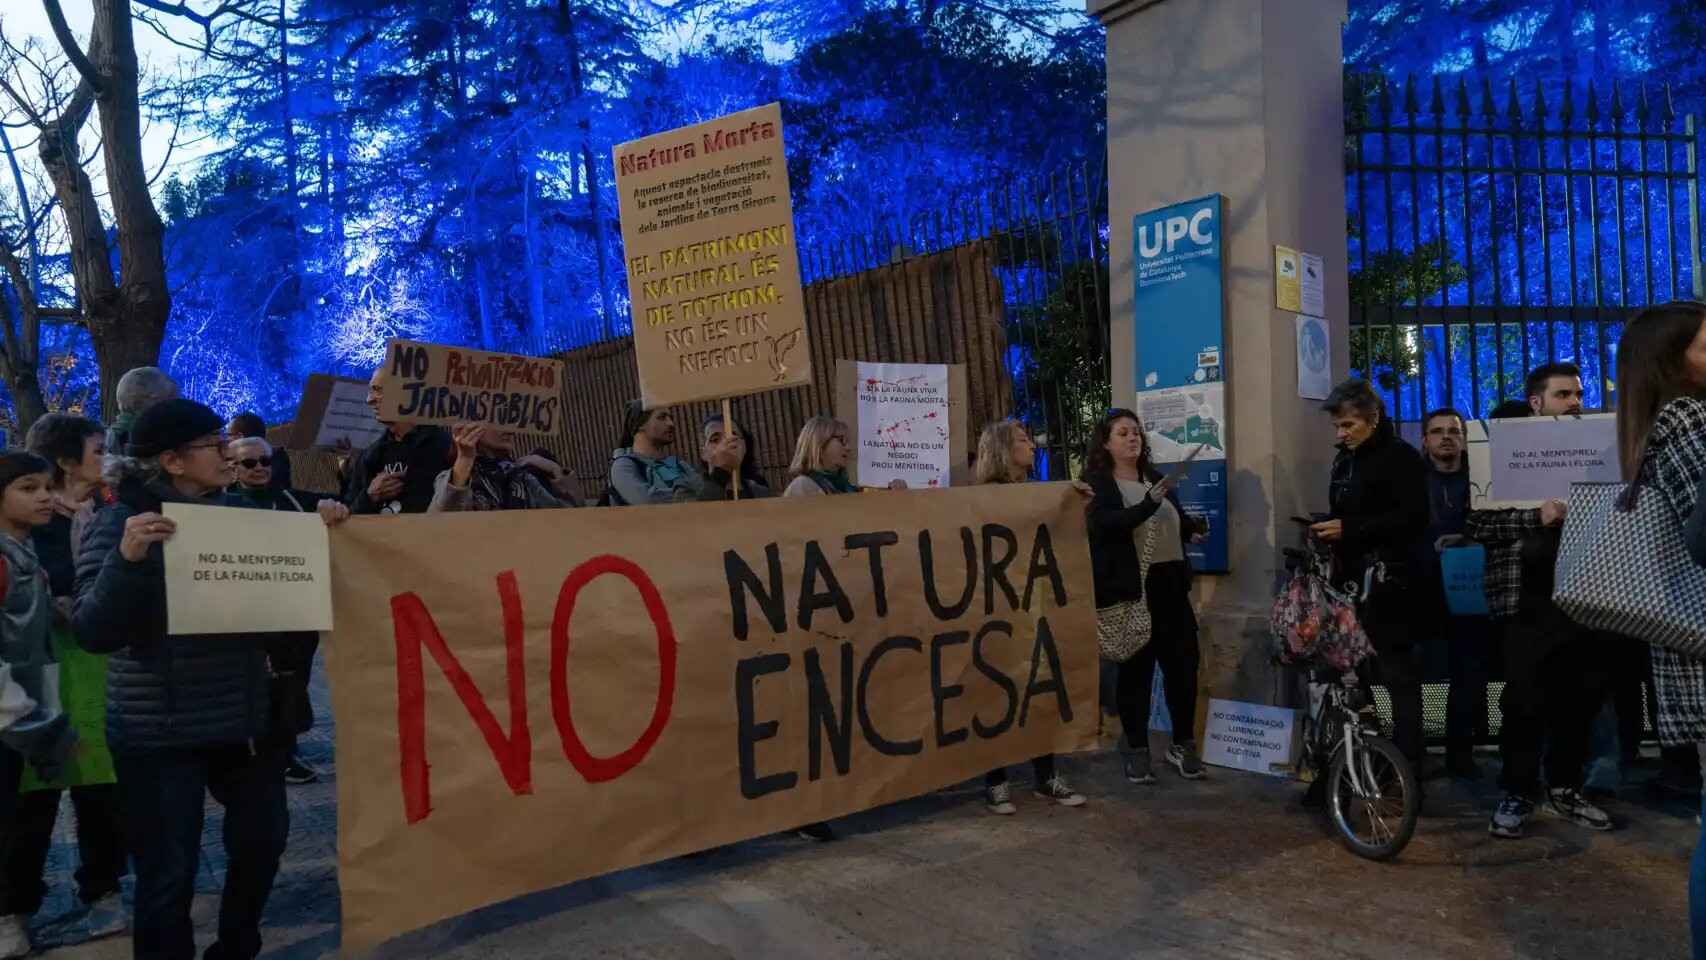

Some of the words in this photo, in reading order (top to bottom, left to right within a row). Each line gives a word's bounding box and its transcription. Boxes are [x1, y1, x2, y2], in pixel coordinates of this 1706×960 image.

[621, 141, 695, 176] Natura
[703, 121, 775, 154] Morta
[634, 182, 666, 199] Aquest
[669, 168, 720, 188] espectacle
[637, 199, 646, 209] la
[649, 191, 684, 207] reserva
[686, 186, 698, 196] de
[701, 170, 771, 194] biodiversitat,
[657, 200, 694, 217] animals
[696, 197, 700, 208] i
[702, 186, 752, 206] vegetació
[639, 220, 658, 234] dels
[660, 213, 695, 229] Jardins
[697, 209, 710, 220] de
[711, 202, 740, 217] Torre
[742, 194, 776, 209] Girona
[630, 255, 655, 277] EL
[660, 224, 788, 270] PATRIMONI
[1138, 208, 1213, 258] UPC
[643, 263, 745, 300] NATURAL
[750, 252, 780, 278] ÉS
[646, 303, 675, 328] DE
[679, 283, 784, 321] TOTHOM.
[664, 326, 696, 351] NO
[702, 316, 729, 341] ÉS
[736, 312, 769, 336] UN
[391, 343, 429, 380] NO
[679, 341, 759, 375] NEGOCI
[398, 382, 487, 422] JARDINS
[860, 394, 871, 402] NO
[880, 395, 889, 403] LA
[890, 395, 916, 403] FAUNA
[881, 384, 890, 393] LA
[892, 384, 918, 393] FAUNA
[871, 461, 893, 469] PROU
[894, 462, 934, 470] MENTIDES
[1508, 461, 1521, 470] DE
[1522, 461, 1535, 469] LA
[1535, 461, 1568, 469] FAUNA
[1574, 459, 1605, 467] FLORA
[1512, 450, 1526, 458] NO
[1528, 450, 1537, 458] AL
[1540, 448, 1598, 457] MENYSPREU
[194, 570, 211, 581] DE
[215, 570, 230, 581] LA
[232, 570, 272, 581] FAUNA
[280, 571, 314, 582] FLORA
[198, 553, 218, 564] NO
[221, 554, 236, 564] AL
[238, 554, 305, 567] MENYSPREU
[723, 522, 1068, 641] NATURA
[390, 554, 678, 824] NO
[735, 617, 1074, 799] ENCESA
[1213, 711, 1224, 720] NO
[1210, 733, 1222, 741] NO
